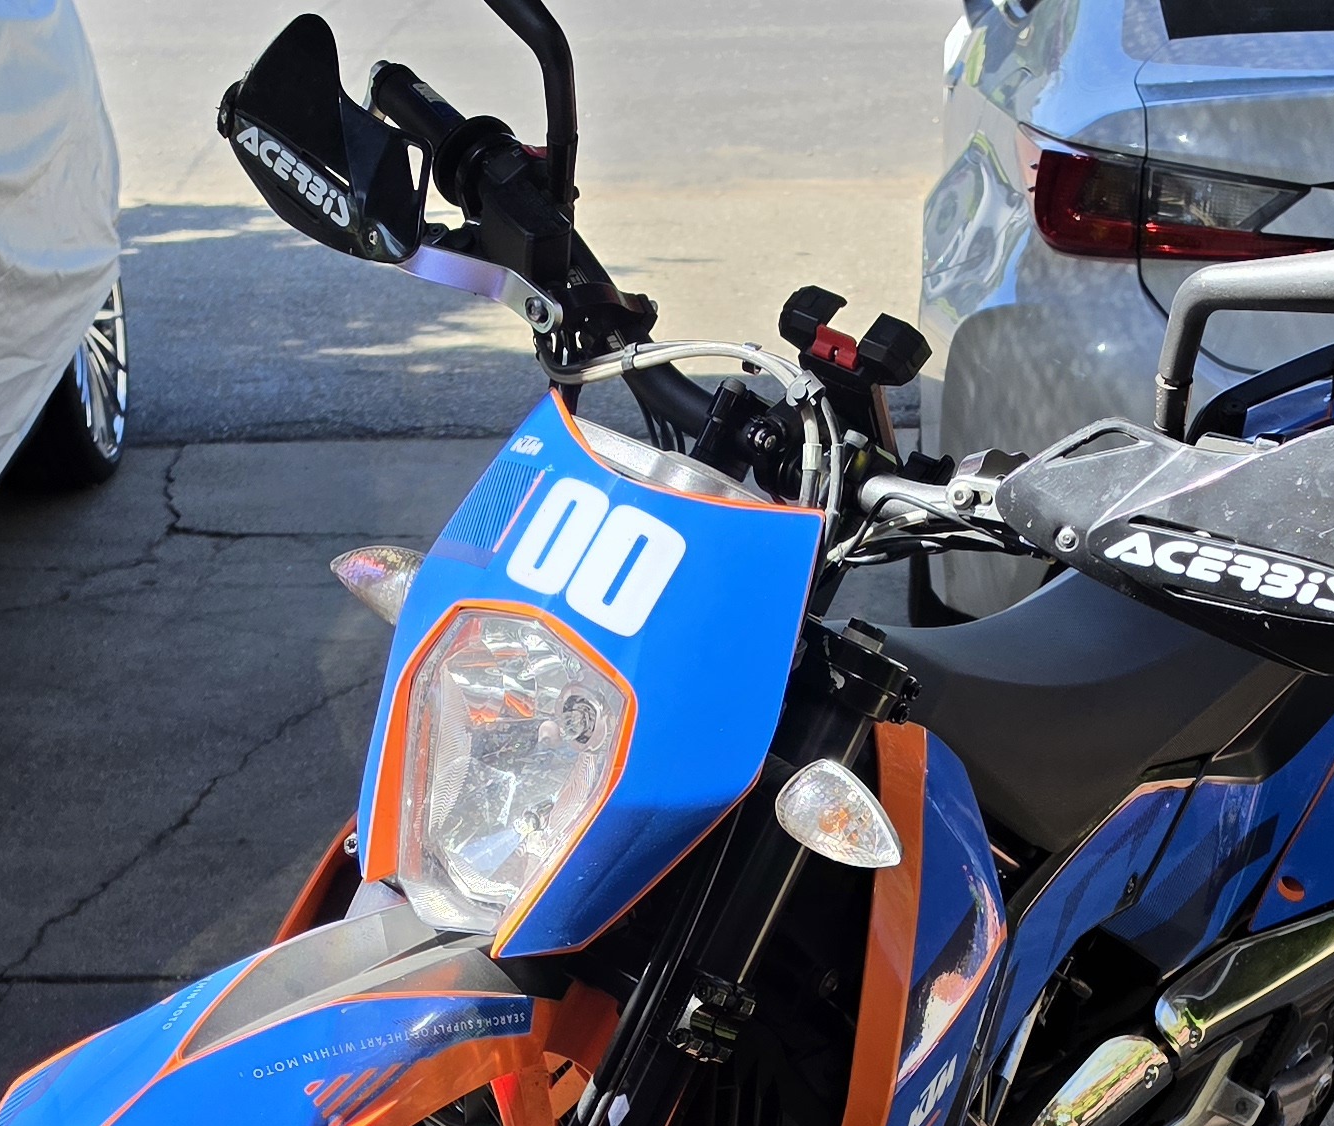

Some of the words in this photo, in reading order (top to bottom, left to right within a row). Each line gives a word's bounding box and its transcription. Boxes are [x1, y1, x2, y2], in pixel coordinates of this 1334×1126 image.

[510, 435, 544, 456] KTM
[506, 477, 687, 637] 00
[433, 1020, 474, 1035] SUPPLY
[487, 1012, 526, 1027] SEARCH
[360, 1036, 382, 1050] ART
[386, 1033, 410, 1045] THE
[303, 1042, 356, 1064] WITHIN
[253, 1057, 299, 1079] MOTO
